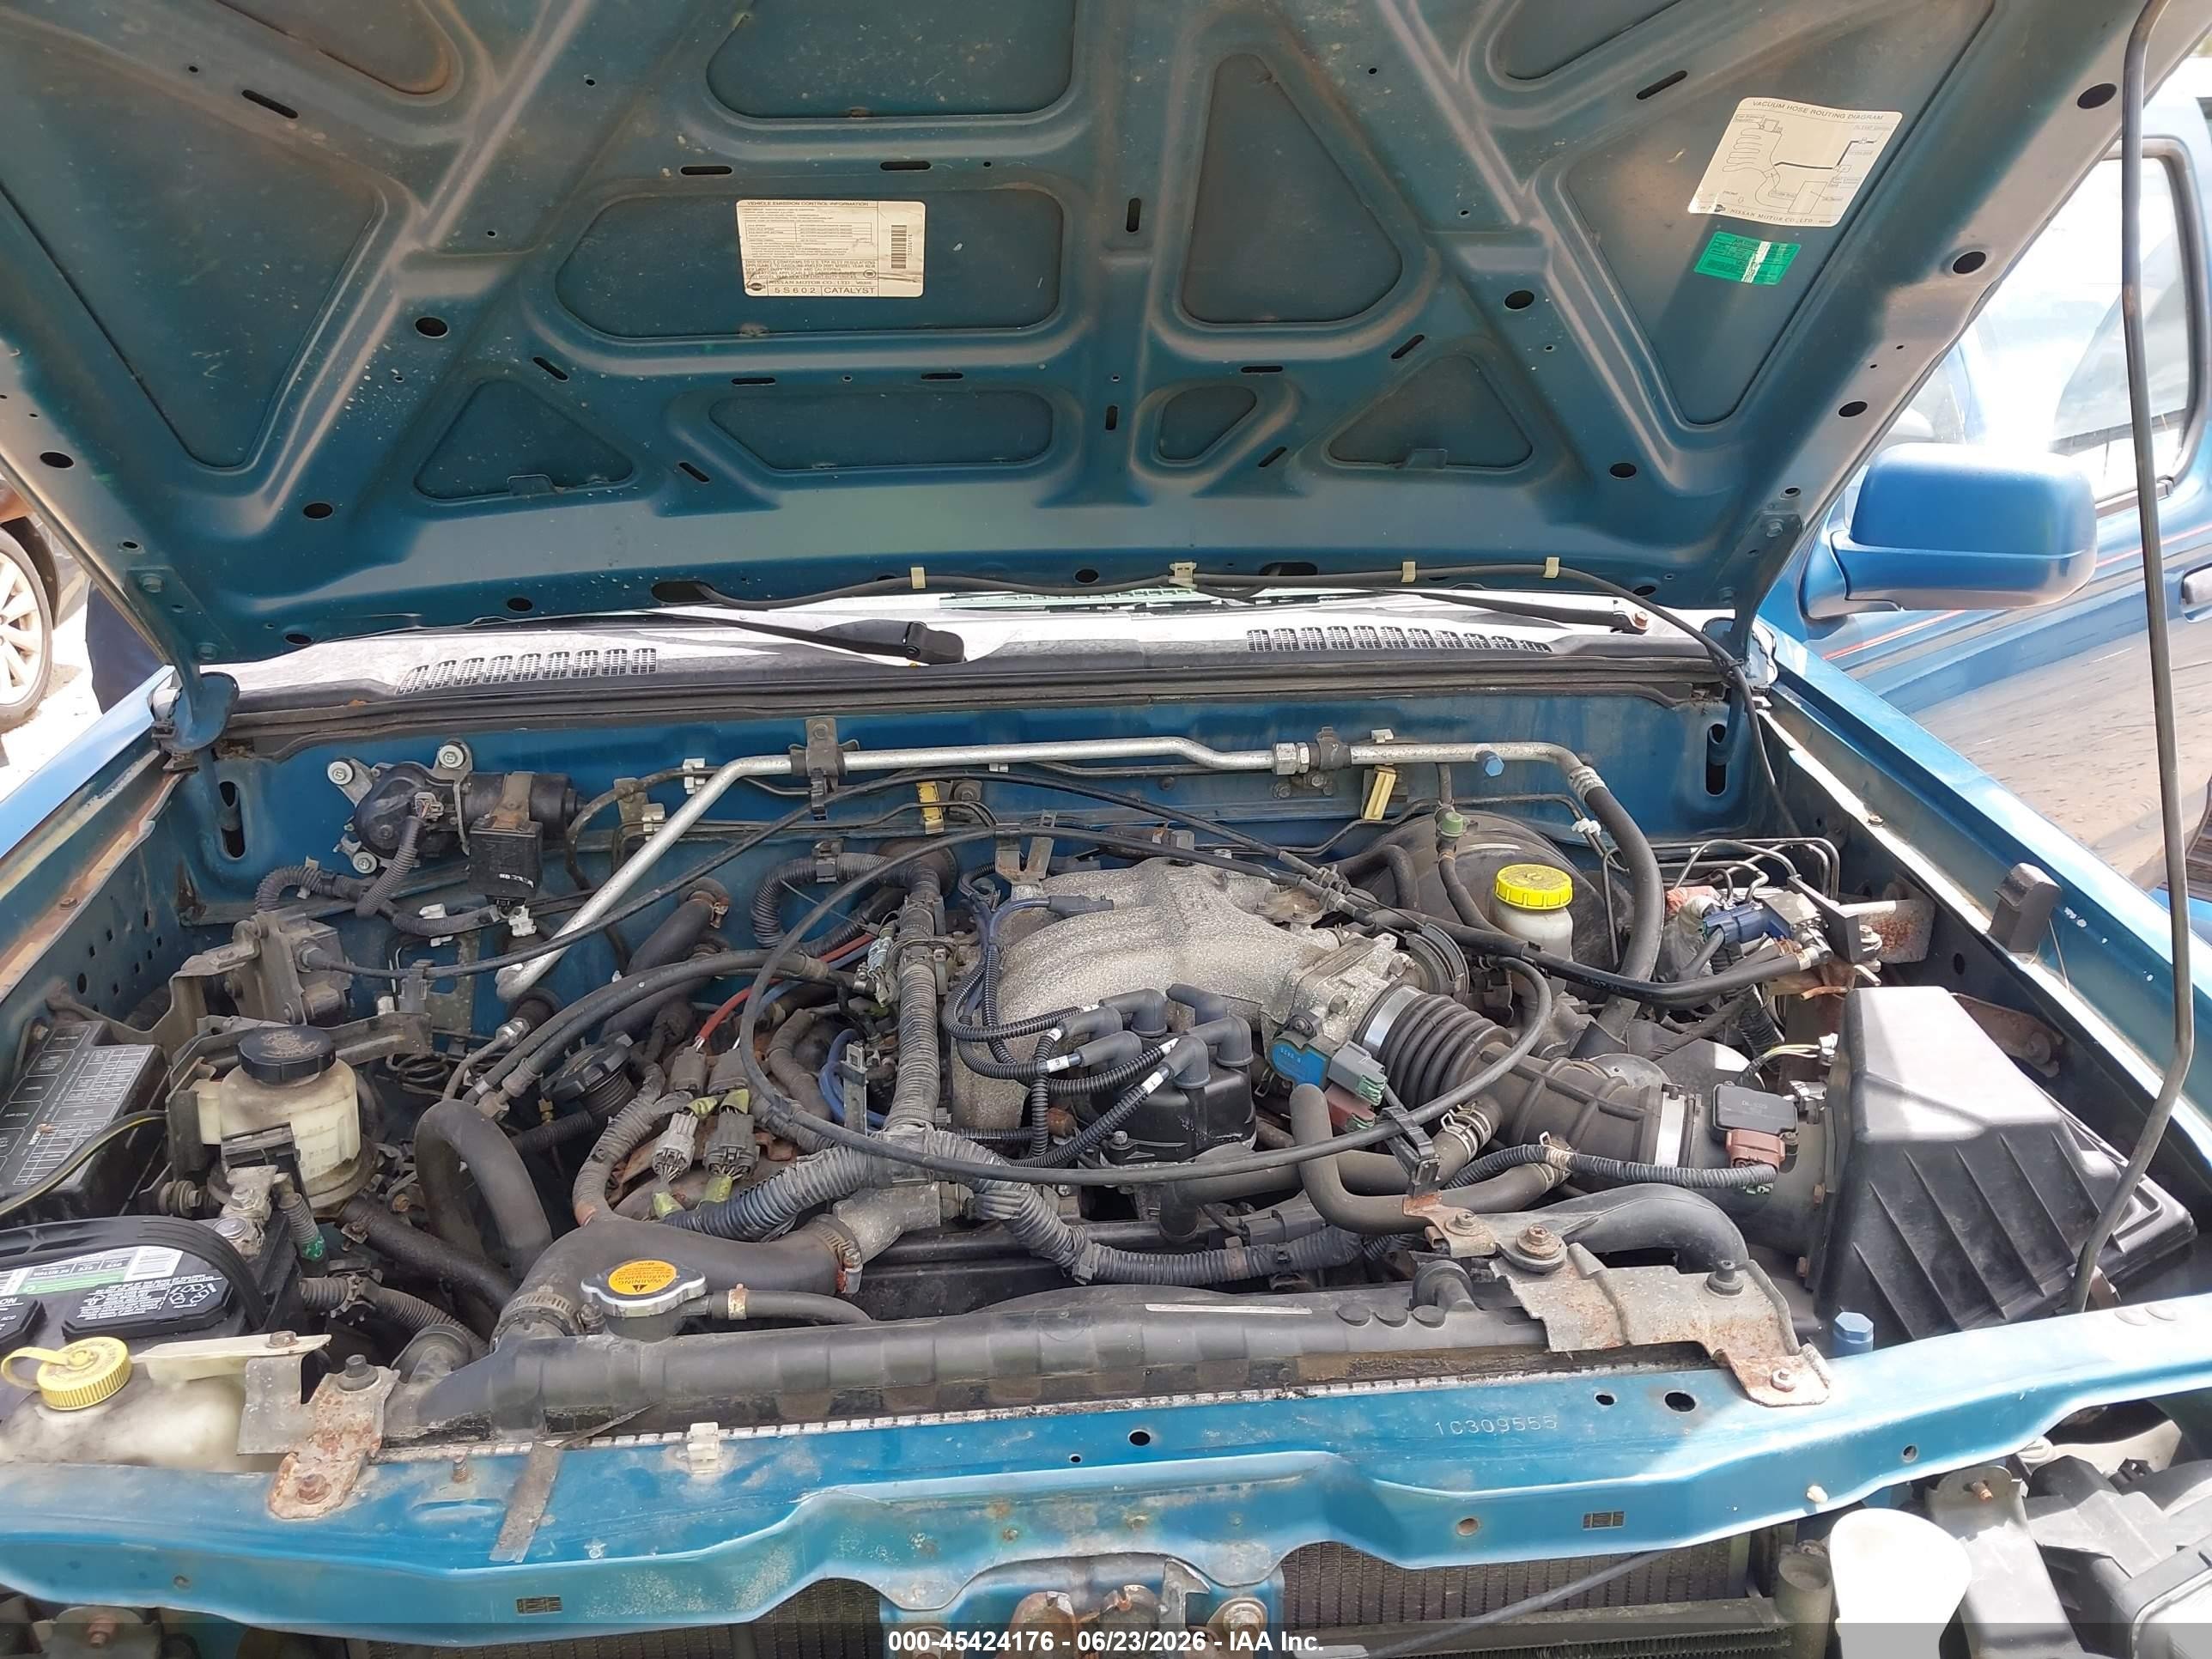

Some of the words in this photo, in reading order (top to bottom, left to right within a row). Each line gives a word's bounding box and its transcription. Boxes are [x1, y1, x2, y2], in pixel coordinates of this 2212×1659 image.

[1753, 100, 1785, 109] VACUUM
[1786, 104, 1808, 113] HOSE
[1809, 109, 1846, 119] ROUTING
[1729, 209, 1755, 217] NISSAN
[1757, 213, 1784, 222] MOTOR
[1435, 1415, 1559, 1436] 1C309555
